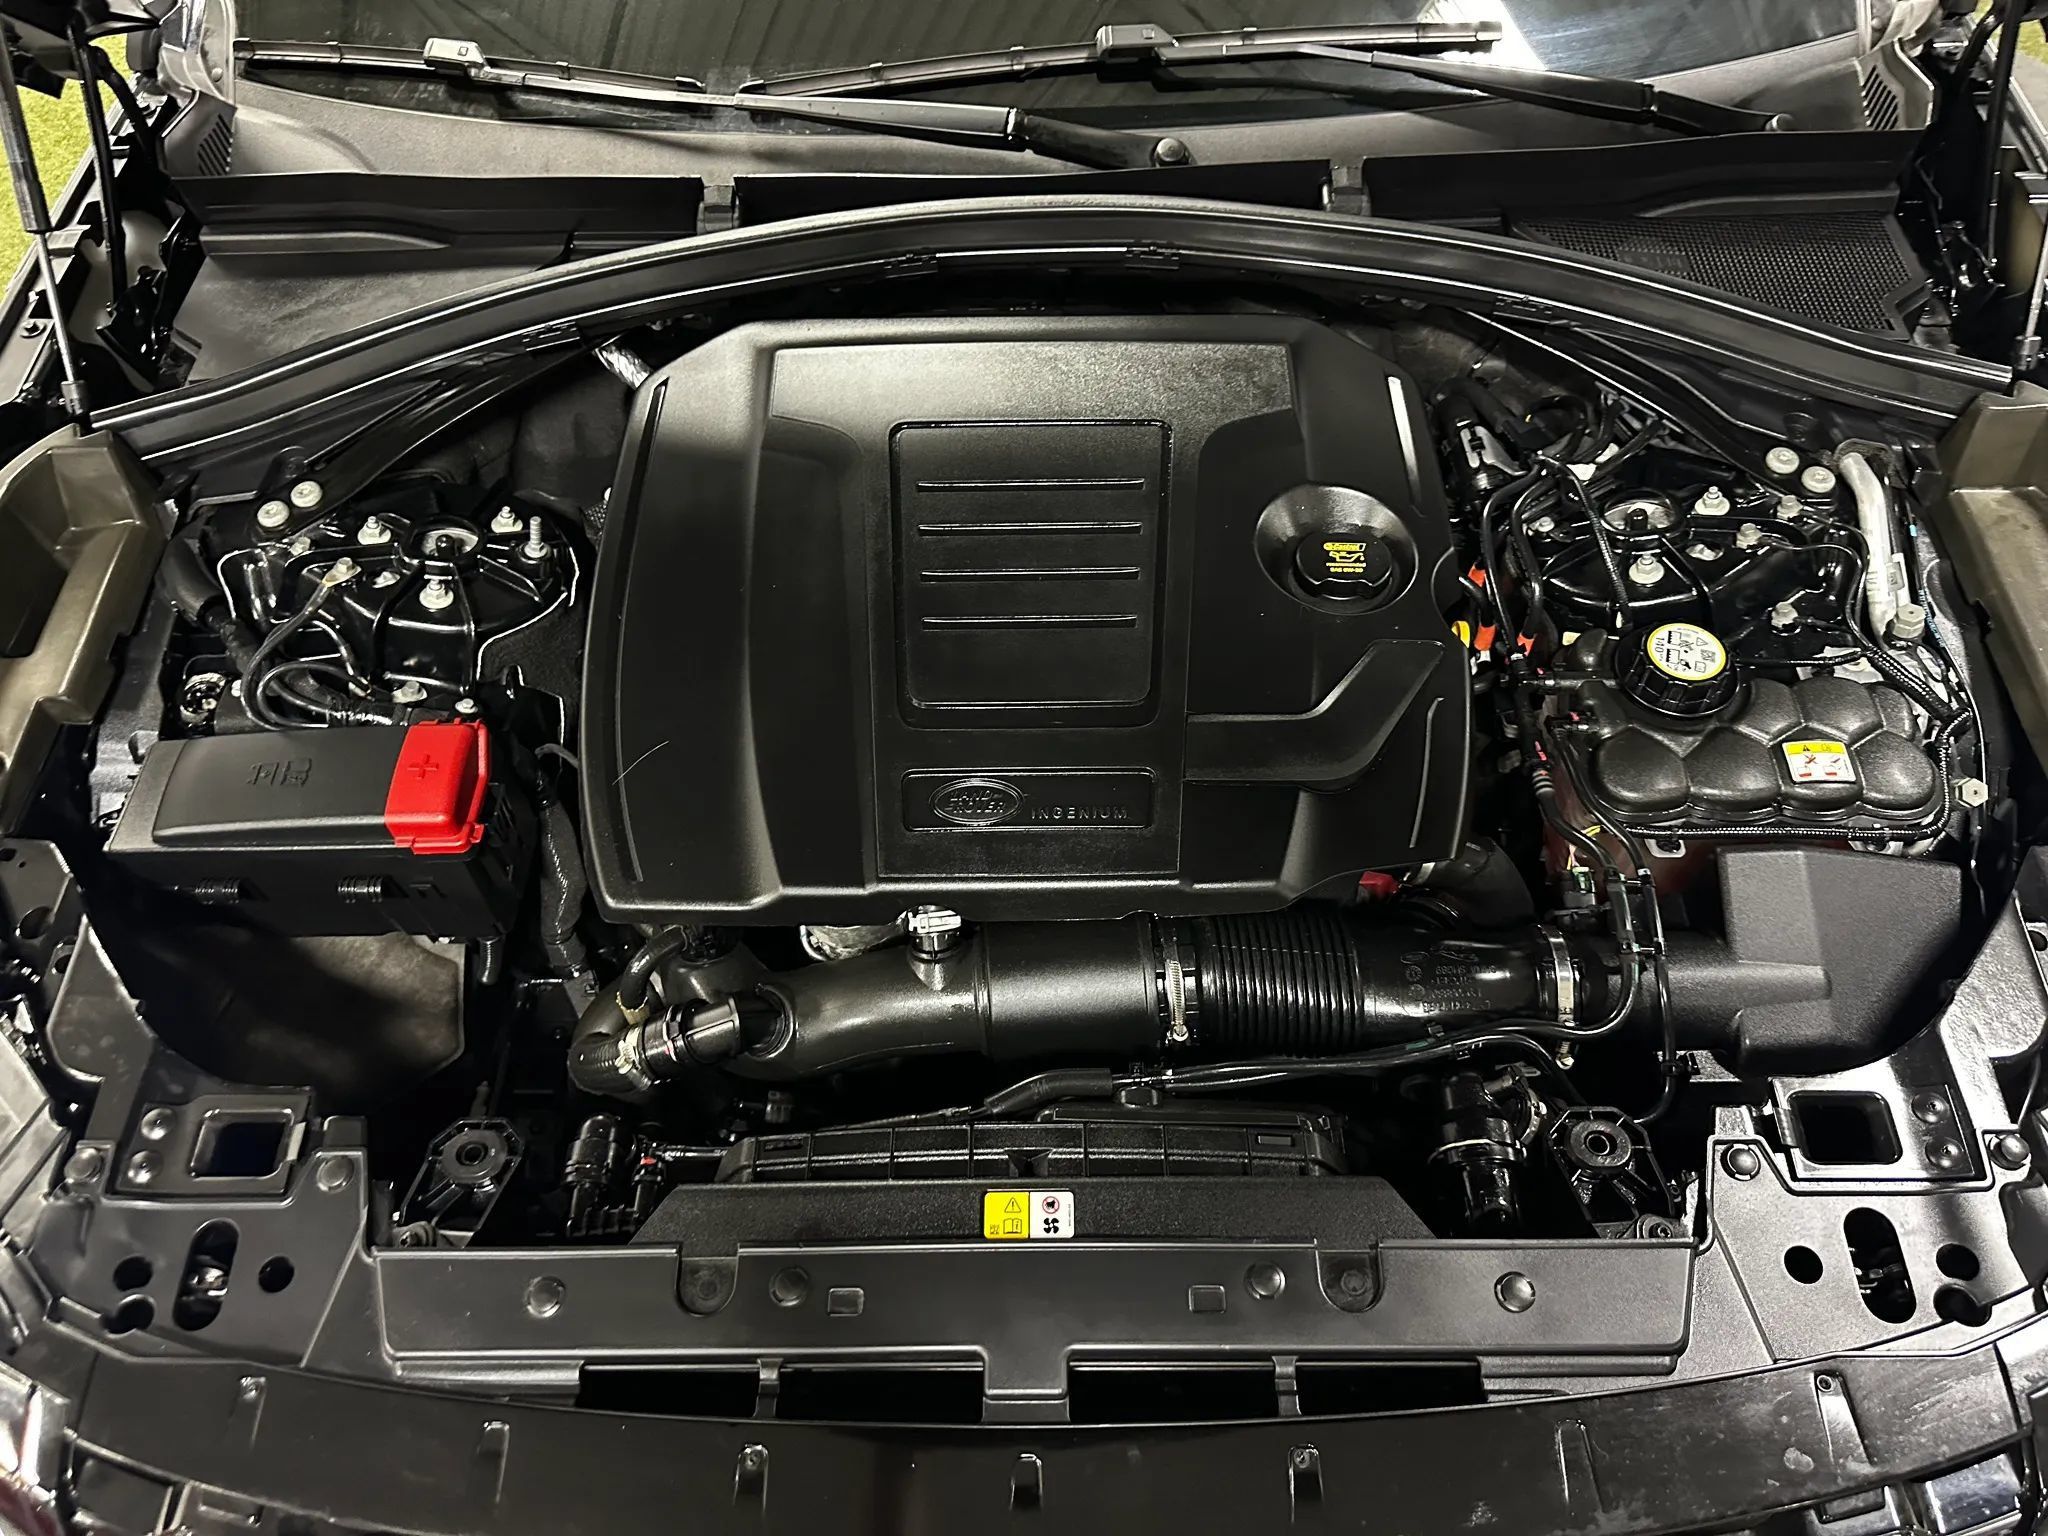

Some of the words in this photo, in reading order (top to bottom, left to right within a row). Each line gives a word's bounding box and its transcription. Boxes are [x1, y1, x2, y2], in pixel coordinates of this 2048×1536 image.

[950, 790, 993, 801] LAND
[952, 801, 1005, 813] ROVER
[1031, 806, 1128, 820] INGENIUM
